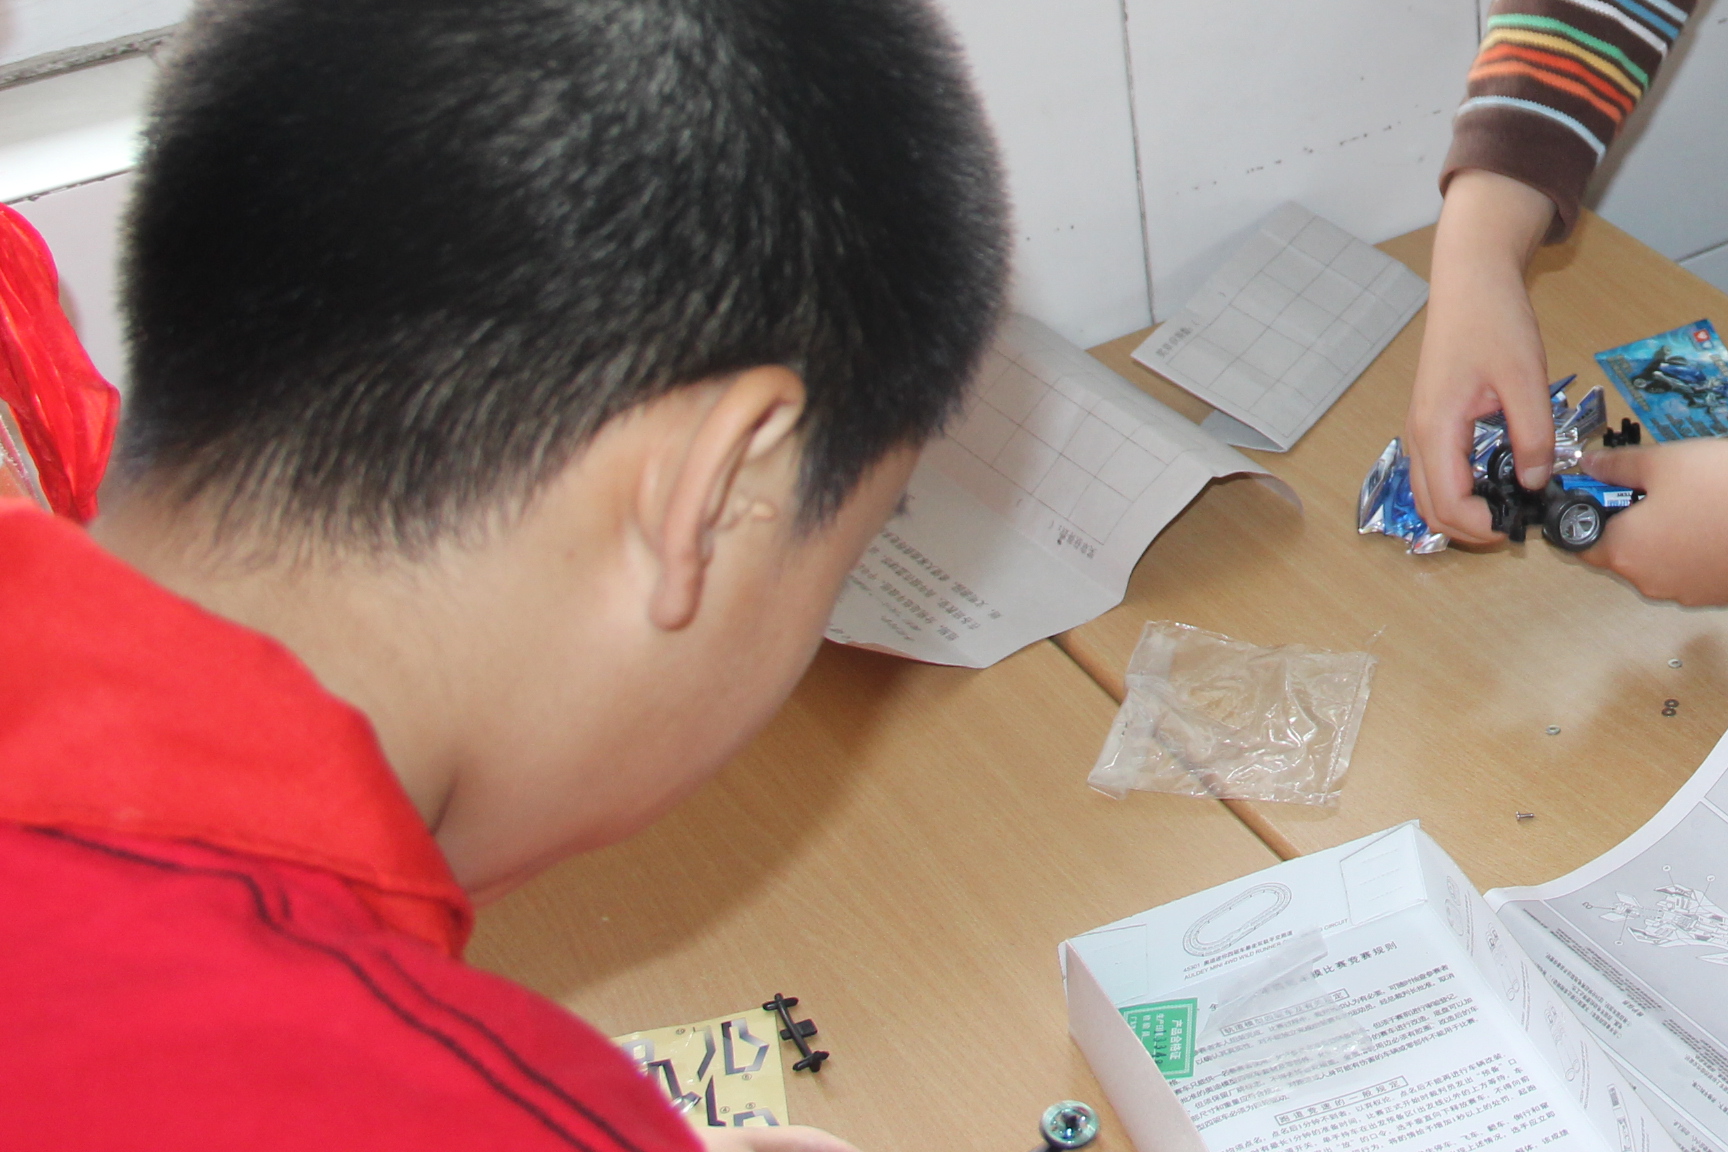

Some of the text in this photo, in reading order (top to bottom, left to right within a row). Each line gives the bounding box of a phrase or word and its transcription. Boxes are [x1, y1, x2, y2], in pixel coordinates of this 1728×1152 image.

[1184, 918, 1349, 980] AULDEY MINI 4WD WILD RUNNER CIRCUIT
[1169, 1019, 1183, 1061] 产品合格证
